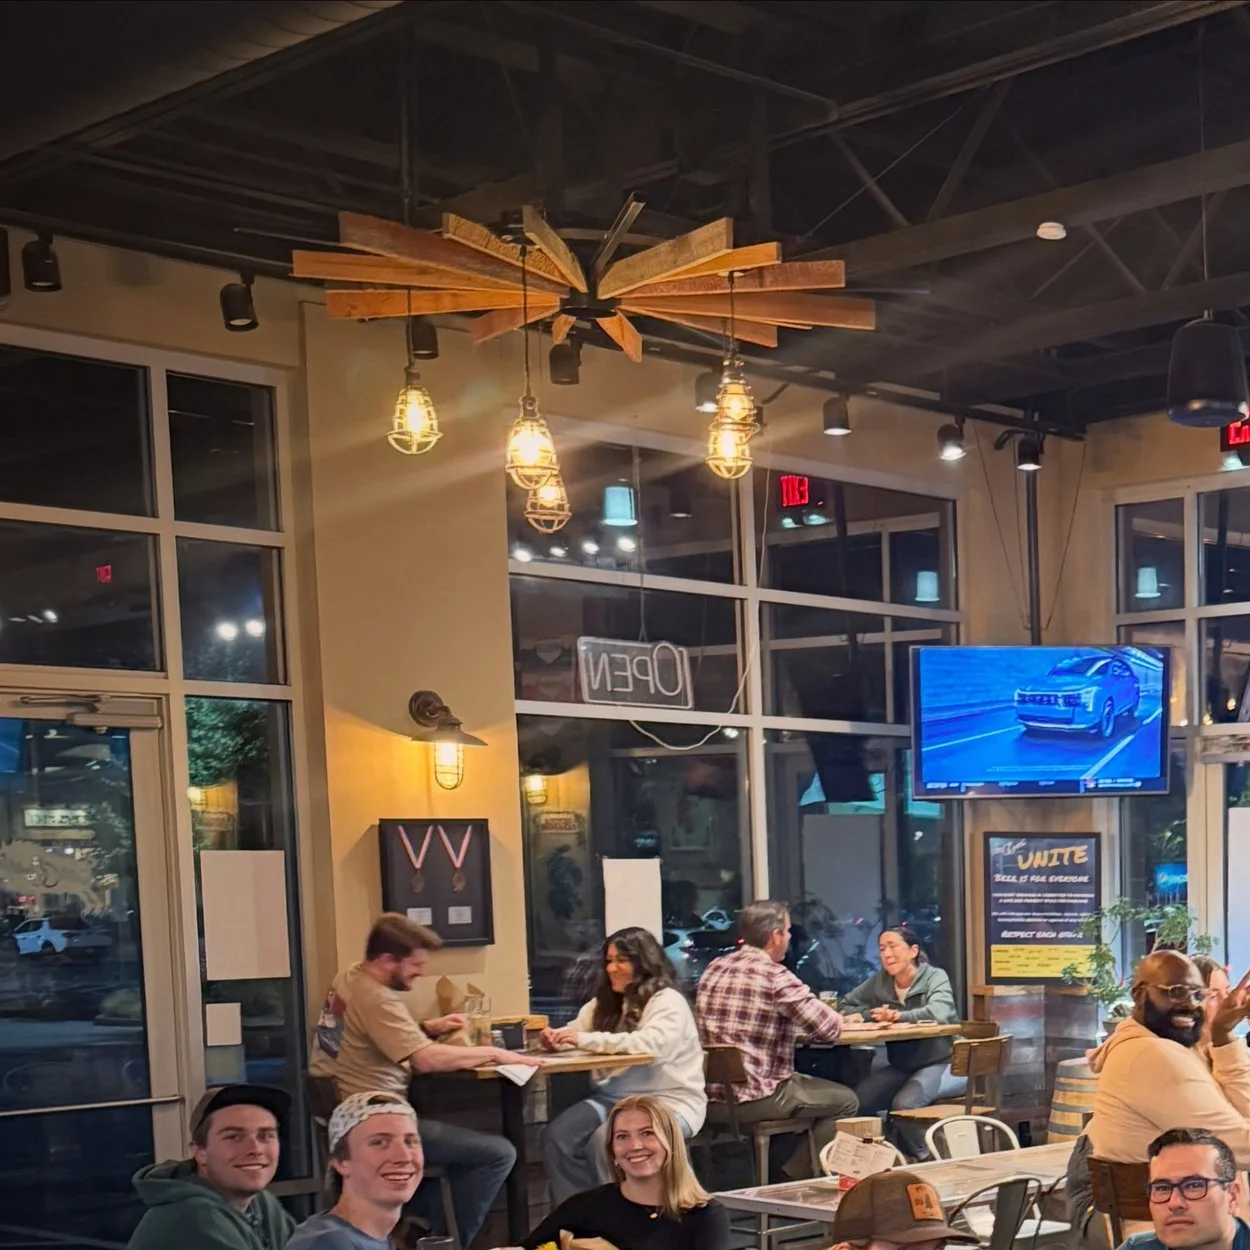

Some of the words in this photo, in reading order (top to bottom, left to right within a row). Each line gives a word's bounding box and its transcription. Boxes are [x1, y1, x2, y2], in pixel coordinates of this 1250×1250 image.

[1017, 845, 1089, 870] UNITE
[1029, 874, 1047, 883] FOR
[1048, 875, 1090, 883] EVERYONE
